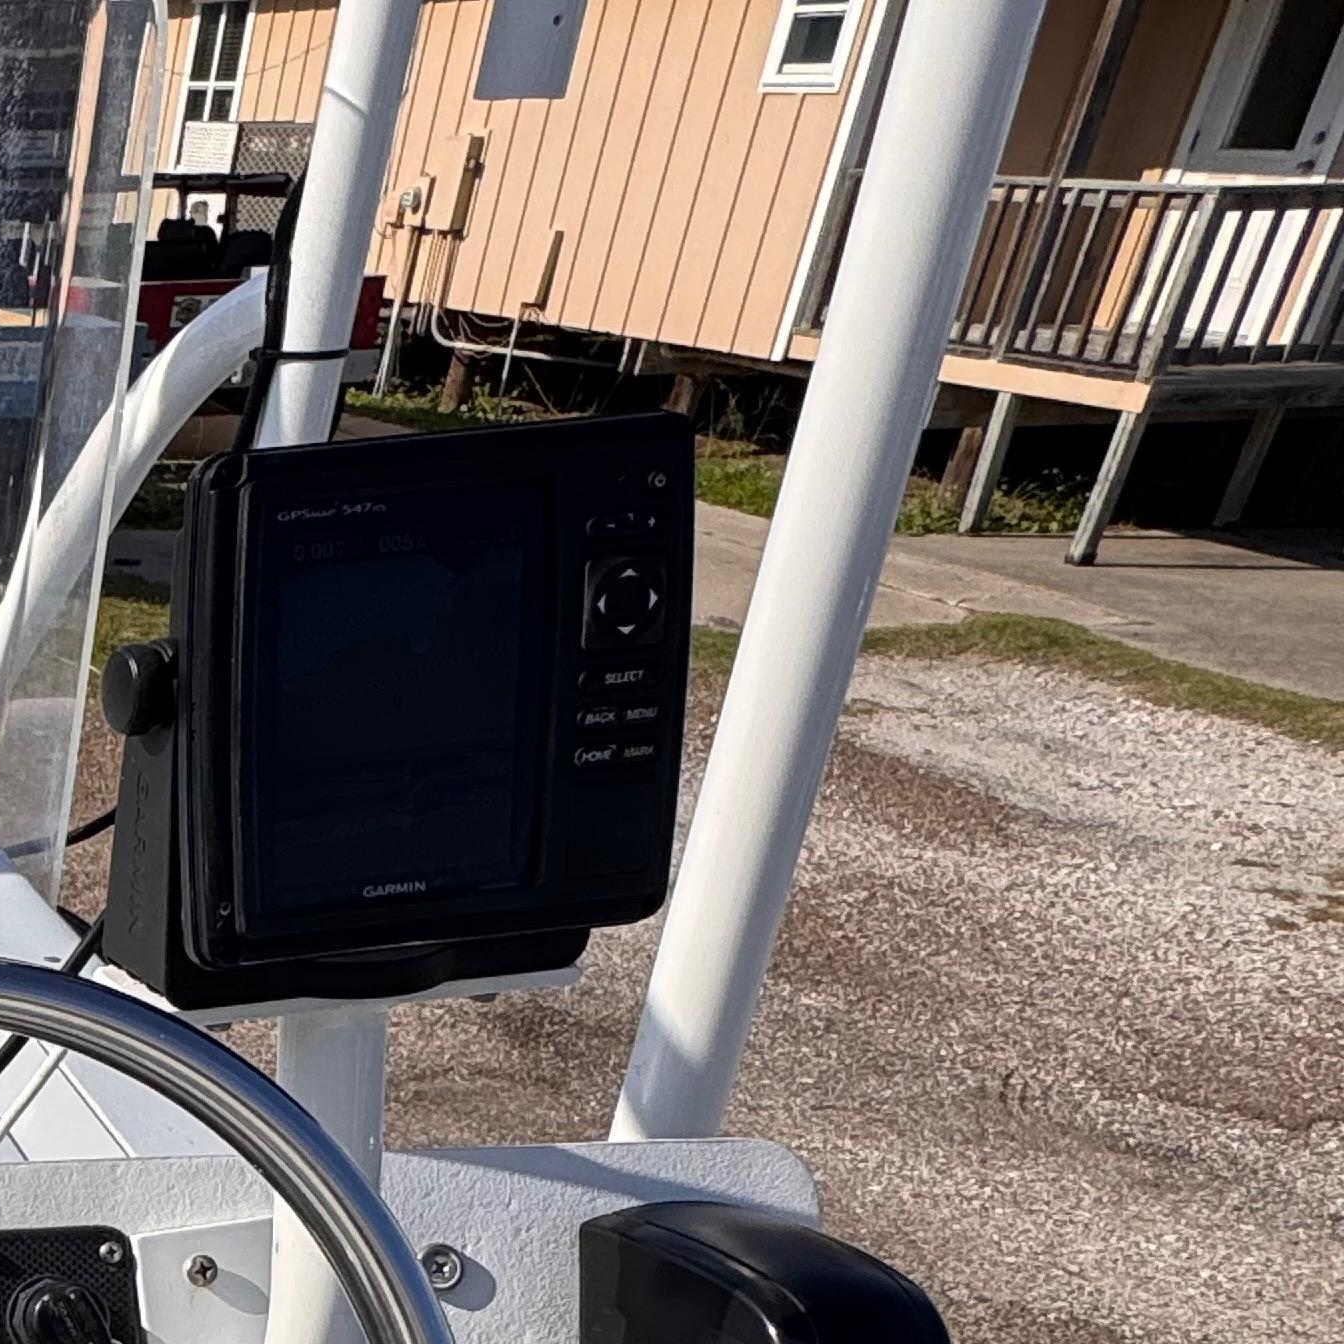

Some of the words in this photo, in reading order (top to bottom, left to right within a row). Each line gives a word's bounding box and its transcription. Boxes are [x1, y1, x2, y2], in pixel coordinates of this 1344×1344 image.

[604, 669, 645, 686] SELECT
[585, 711, 616, 726] BACK
[626, 706, 659, 720] MENU
[362, 880, 427, 898] GARMIN
